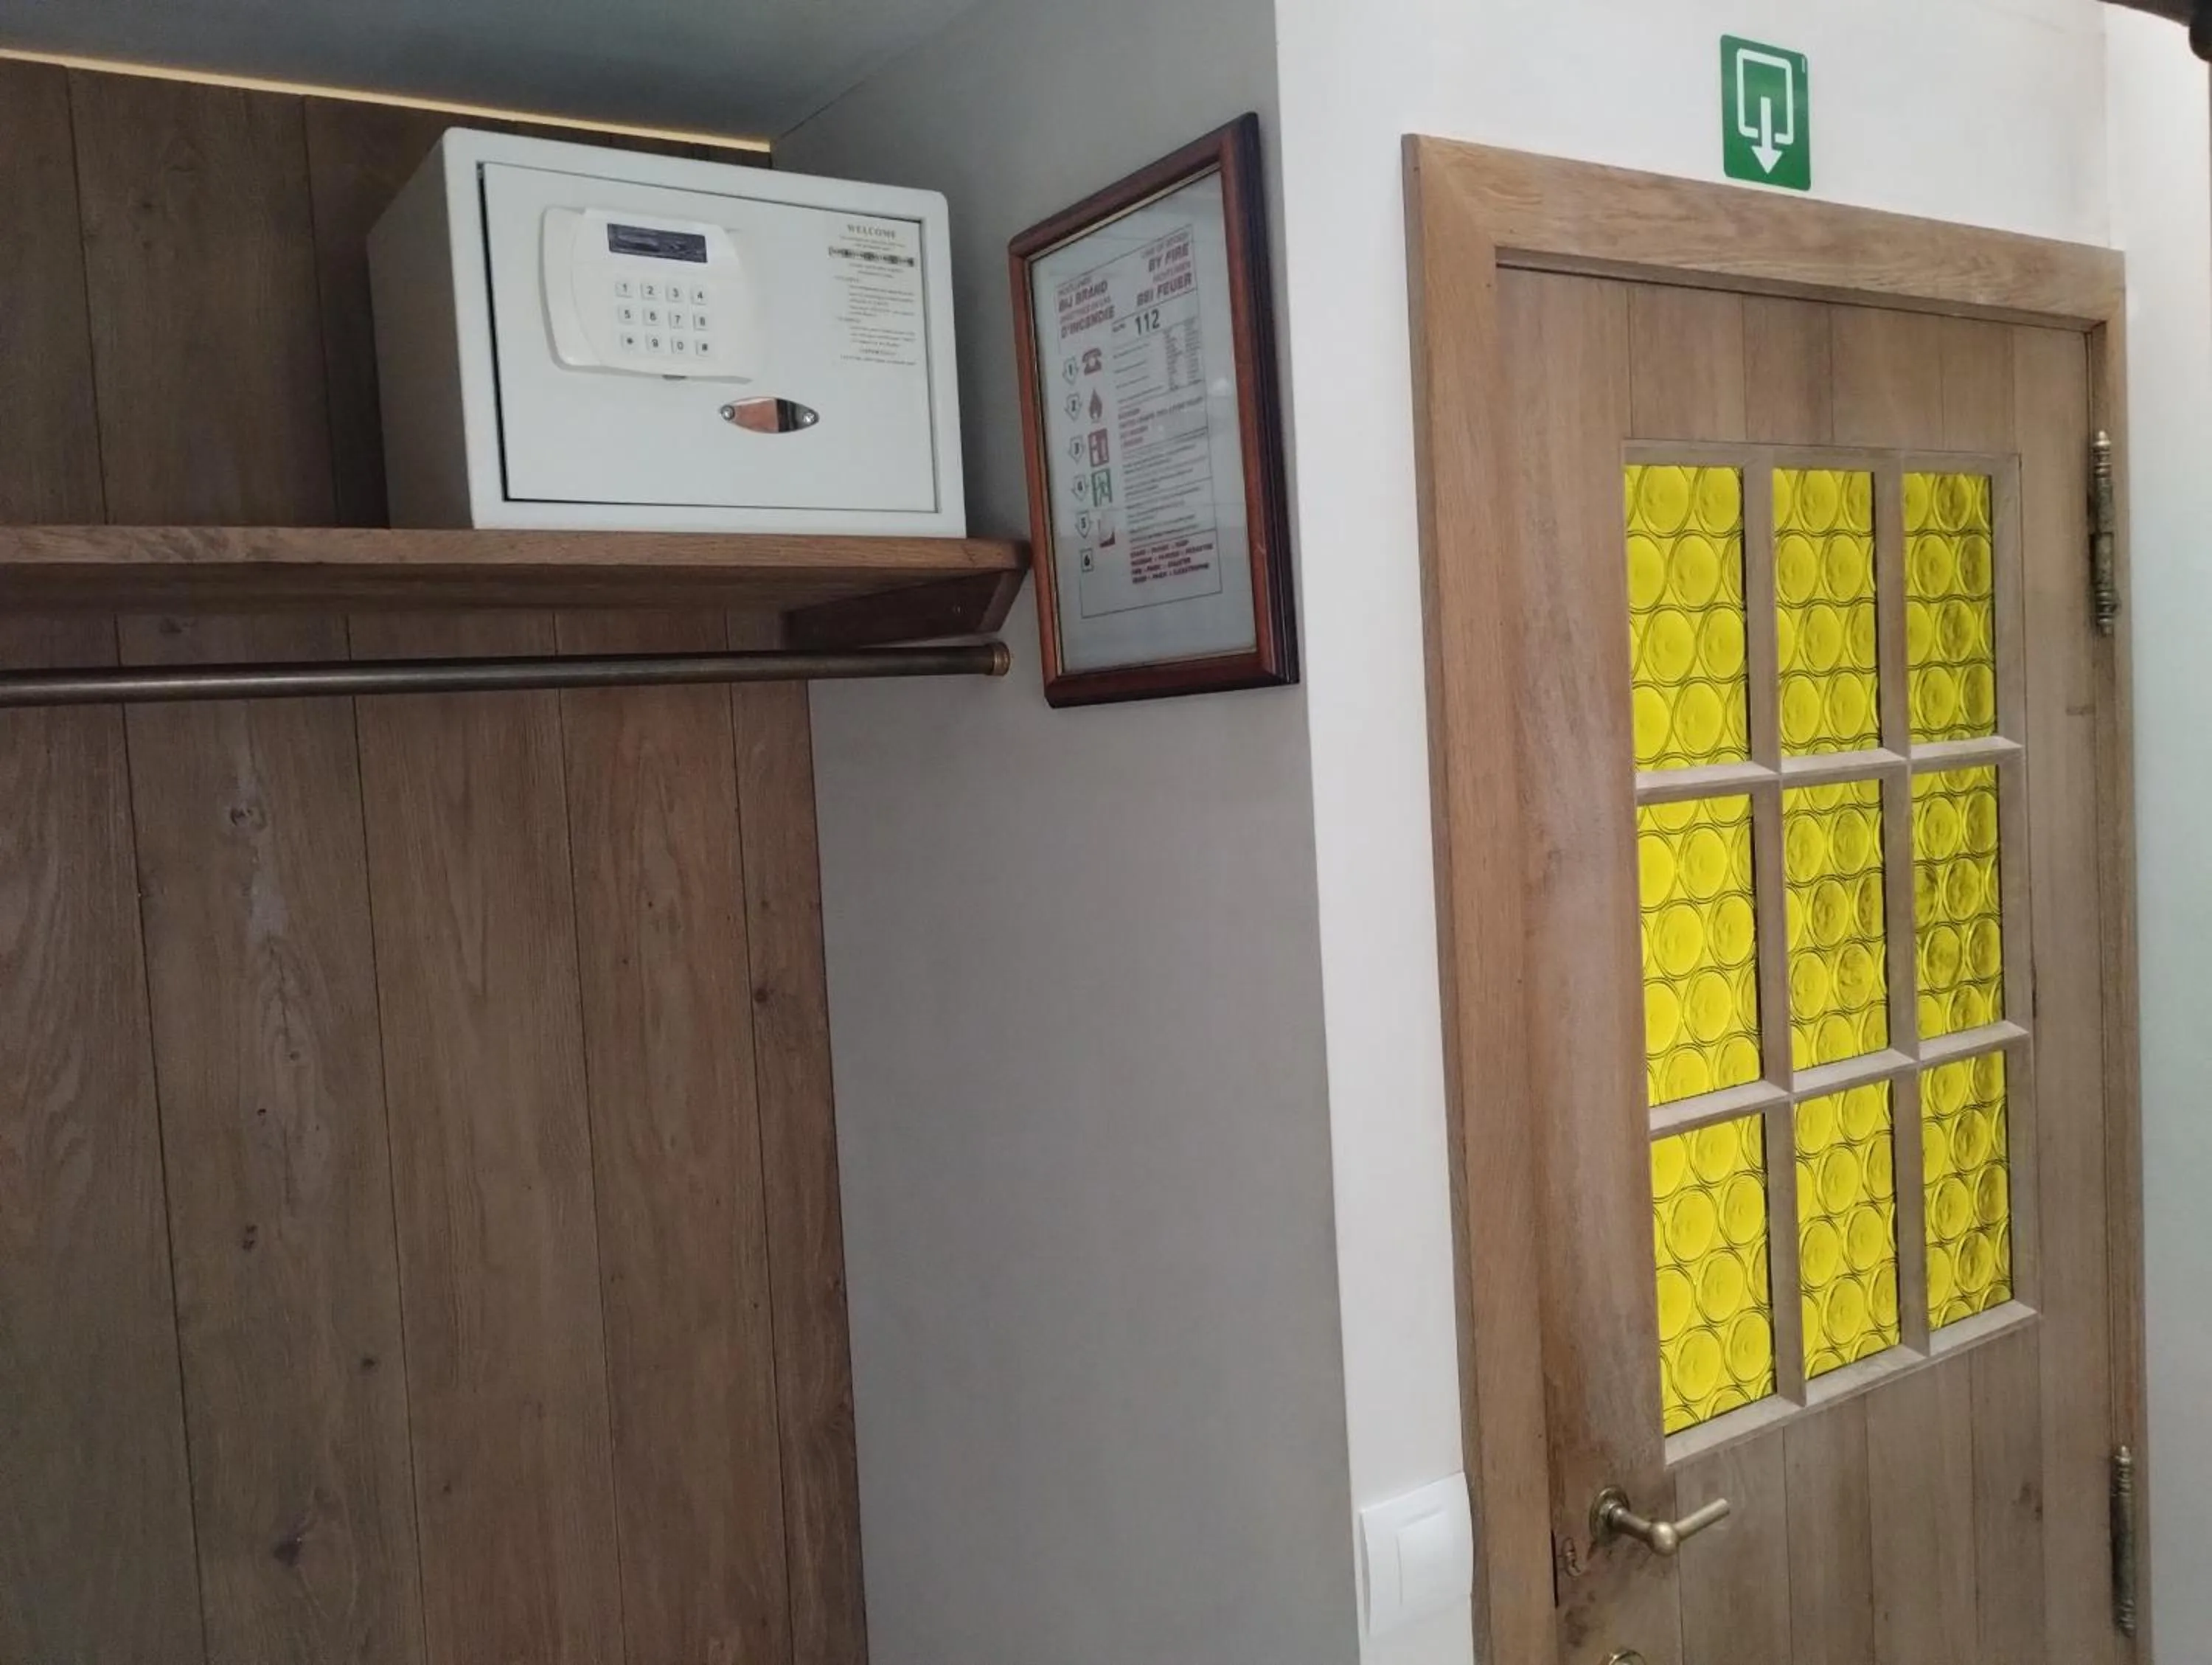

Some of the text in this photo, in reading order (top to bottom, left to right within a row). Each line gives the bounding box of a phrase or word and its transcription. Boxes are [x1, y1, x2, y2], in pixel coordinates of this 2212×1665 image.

[846, 224, 896, 240] WELCOME
[1149, 255, 1163, 273] BY
[1165, 242, 1189, 265] FIRE
[647, 285, 654, 295] 2
[673, 288, 679, 298] 3
[697, 291, 703, 299] 4
[1075, 279, 1108, 305] BRAND
[1156, 272, 1192, 298] FEUER
[625, 309, 631, 319] 5
[650, 311, 656, 321] 6
[675, 314, 681, 324] 7
[1135, 308, 1161, 336] 112
[651, 338, 658, 348] 9
[677, 341, 684, 351] 0
